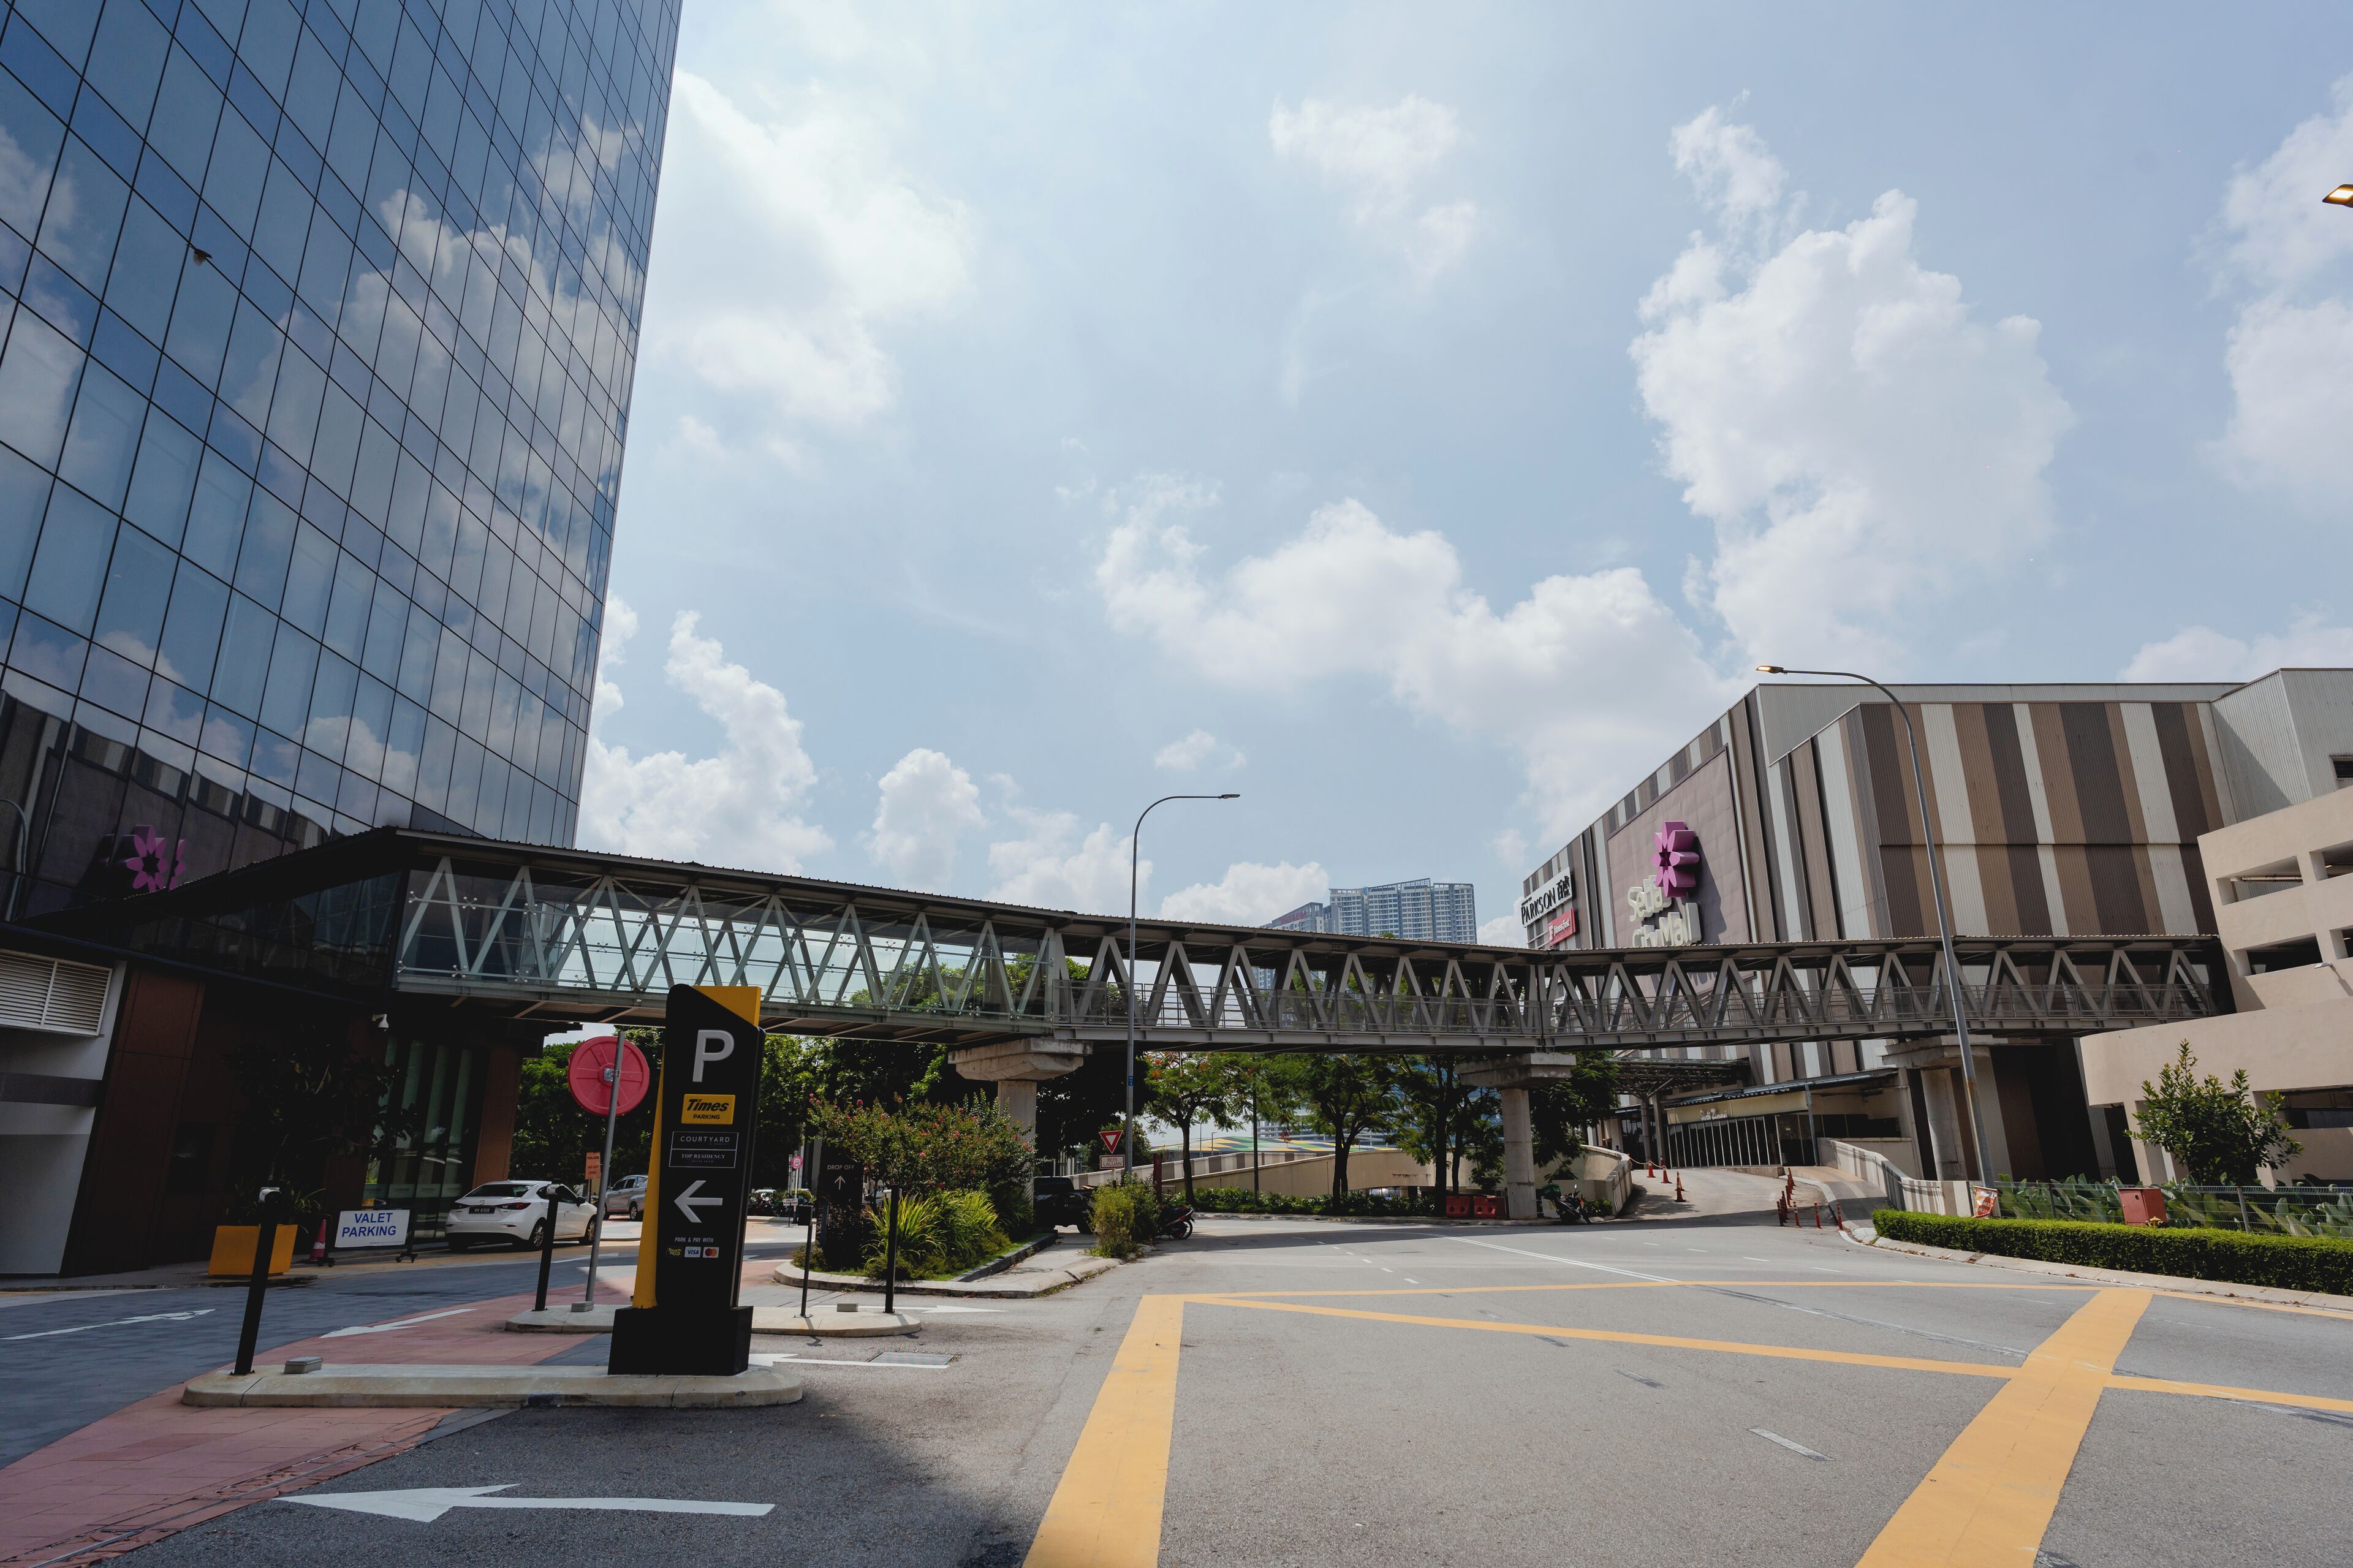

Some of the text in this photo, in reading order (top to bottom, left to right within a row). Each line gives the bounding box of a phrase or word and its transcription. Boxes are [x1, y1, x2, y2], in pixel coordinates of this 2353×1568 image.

[1521, 887, 1556, 925] PARKSON
[1659, 898, 1700, 946] Mall
[692, 1030, 735, 1082] P
[687, 1099, 729, 1112] Times
[342, 1225, 396, 1237] PARKING
[355, 1213, 393, 1224] VALET
